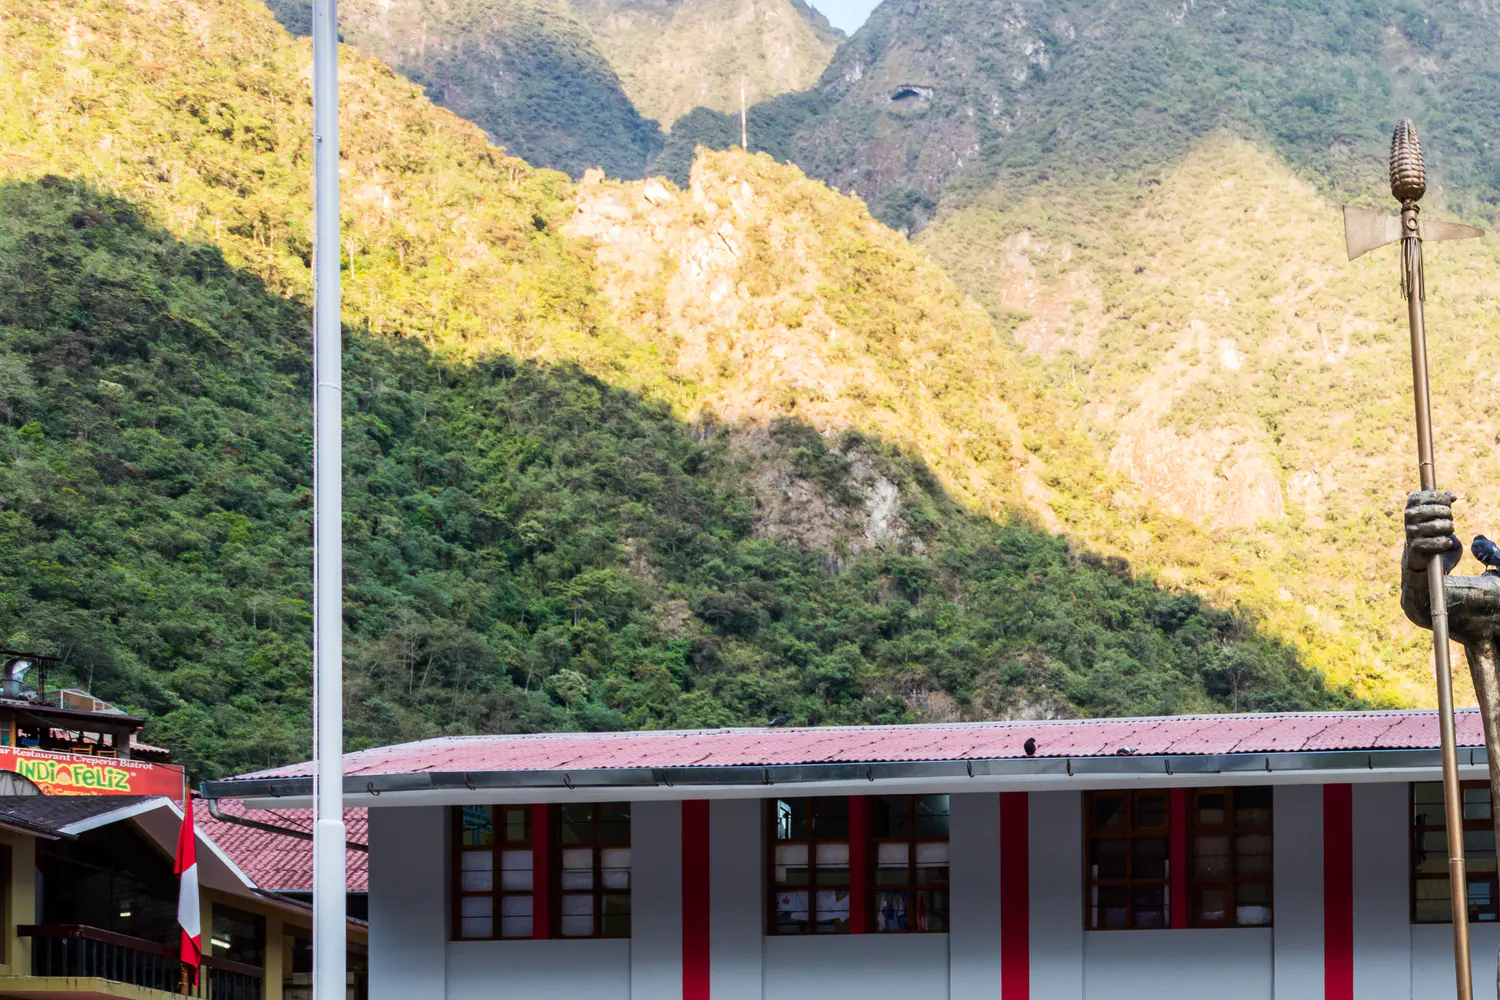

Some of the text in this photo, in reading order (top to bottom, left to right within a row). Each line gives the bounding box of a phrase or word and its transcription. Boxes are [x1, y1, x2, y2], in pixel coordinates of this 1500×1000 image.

[13, 747, 71, 761] Restaurant
[73, 755, 118, 766] Creperie
[120, 760, 153, 770] Bistrot
